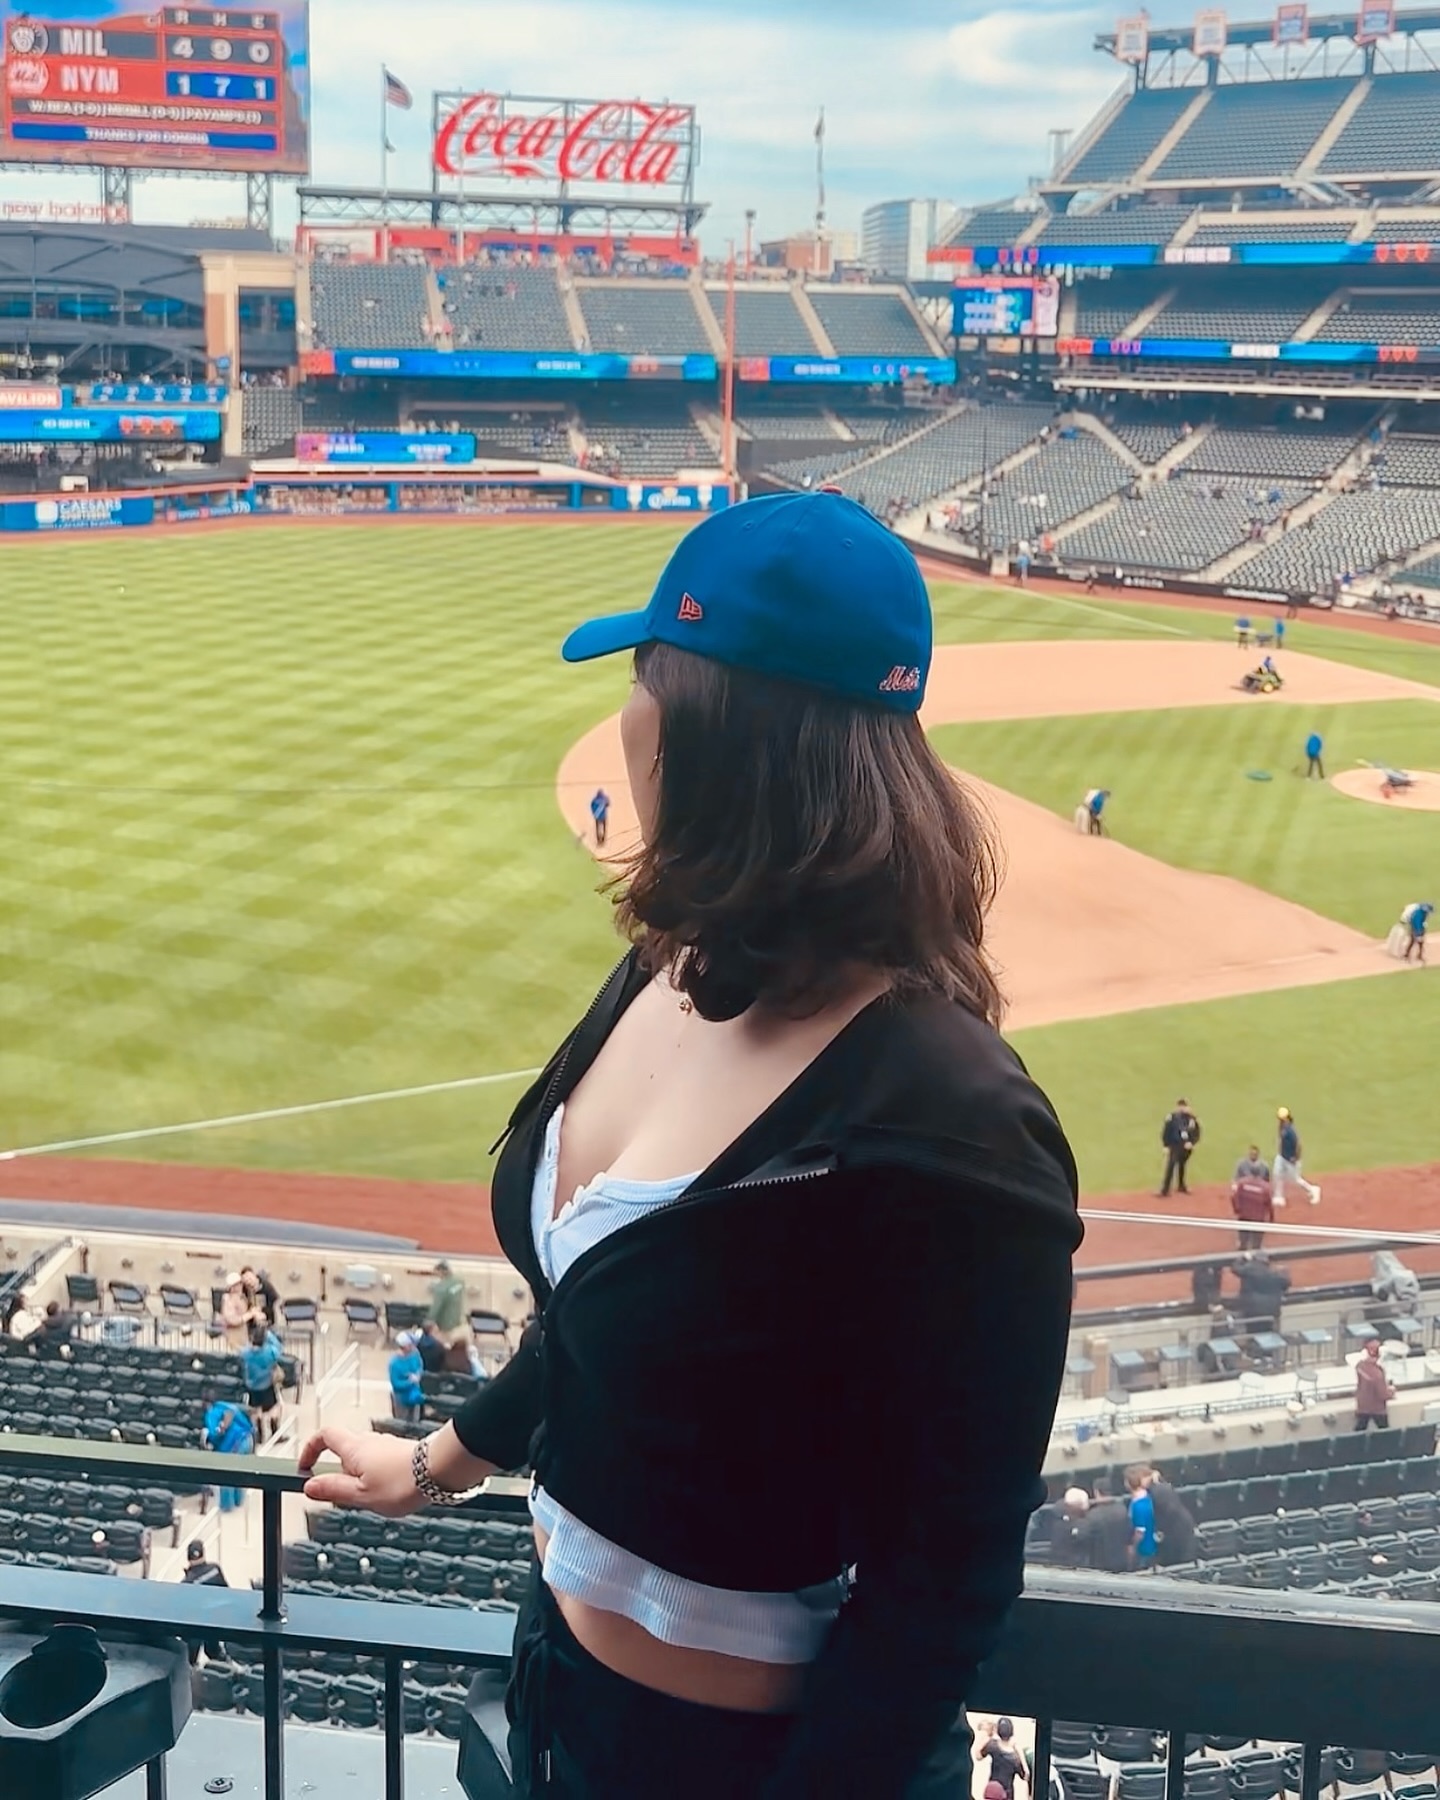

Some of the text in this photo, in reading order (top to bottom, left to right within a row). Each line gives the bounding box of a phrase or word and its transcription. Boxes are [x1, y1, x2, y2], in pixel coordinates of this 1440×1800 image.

[60, 28, 108, 57] MIL
[173, 36, 270, 63] 4 9 0
[60, 65, 119, 94] NYM
[177, 75, 266, 100] 1 7 1
